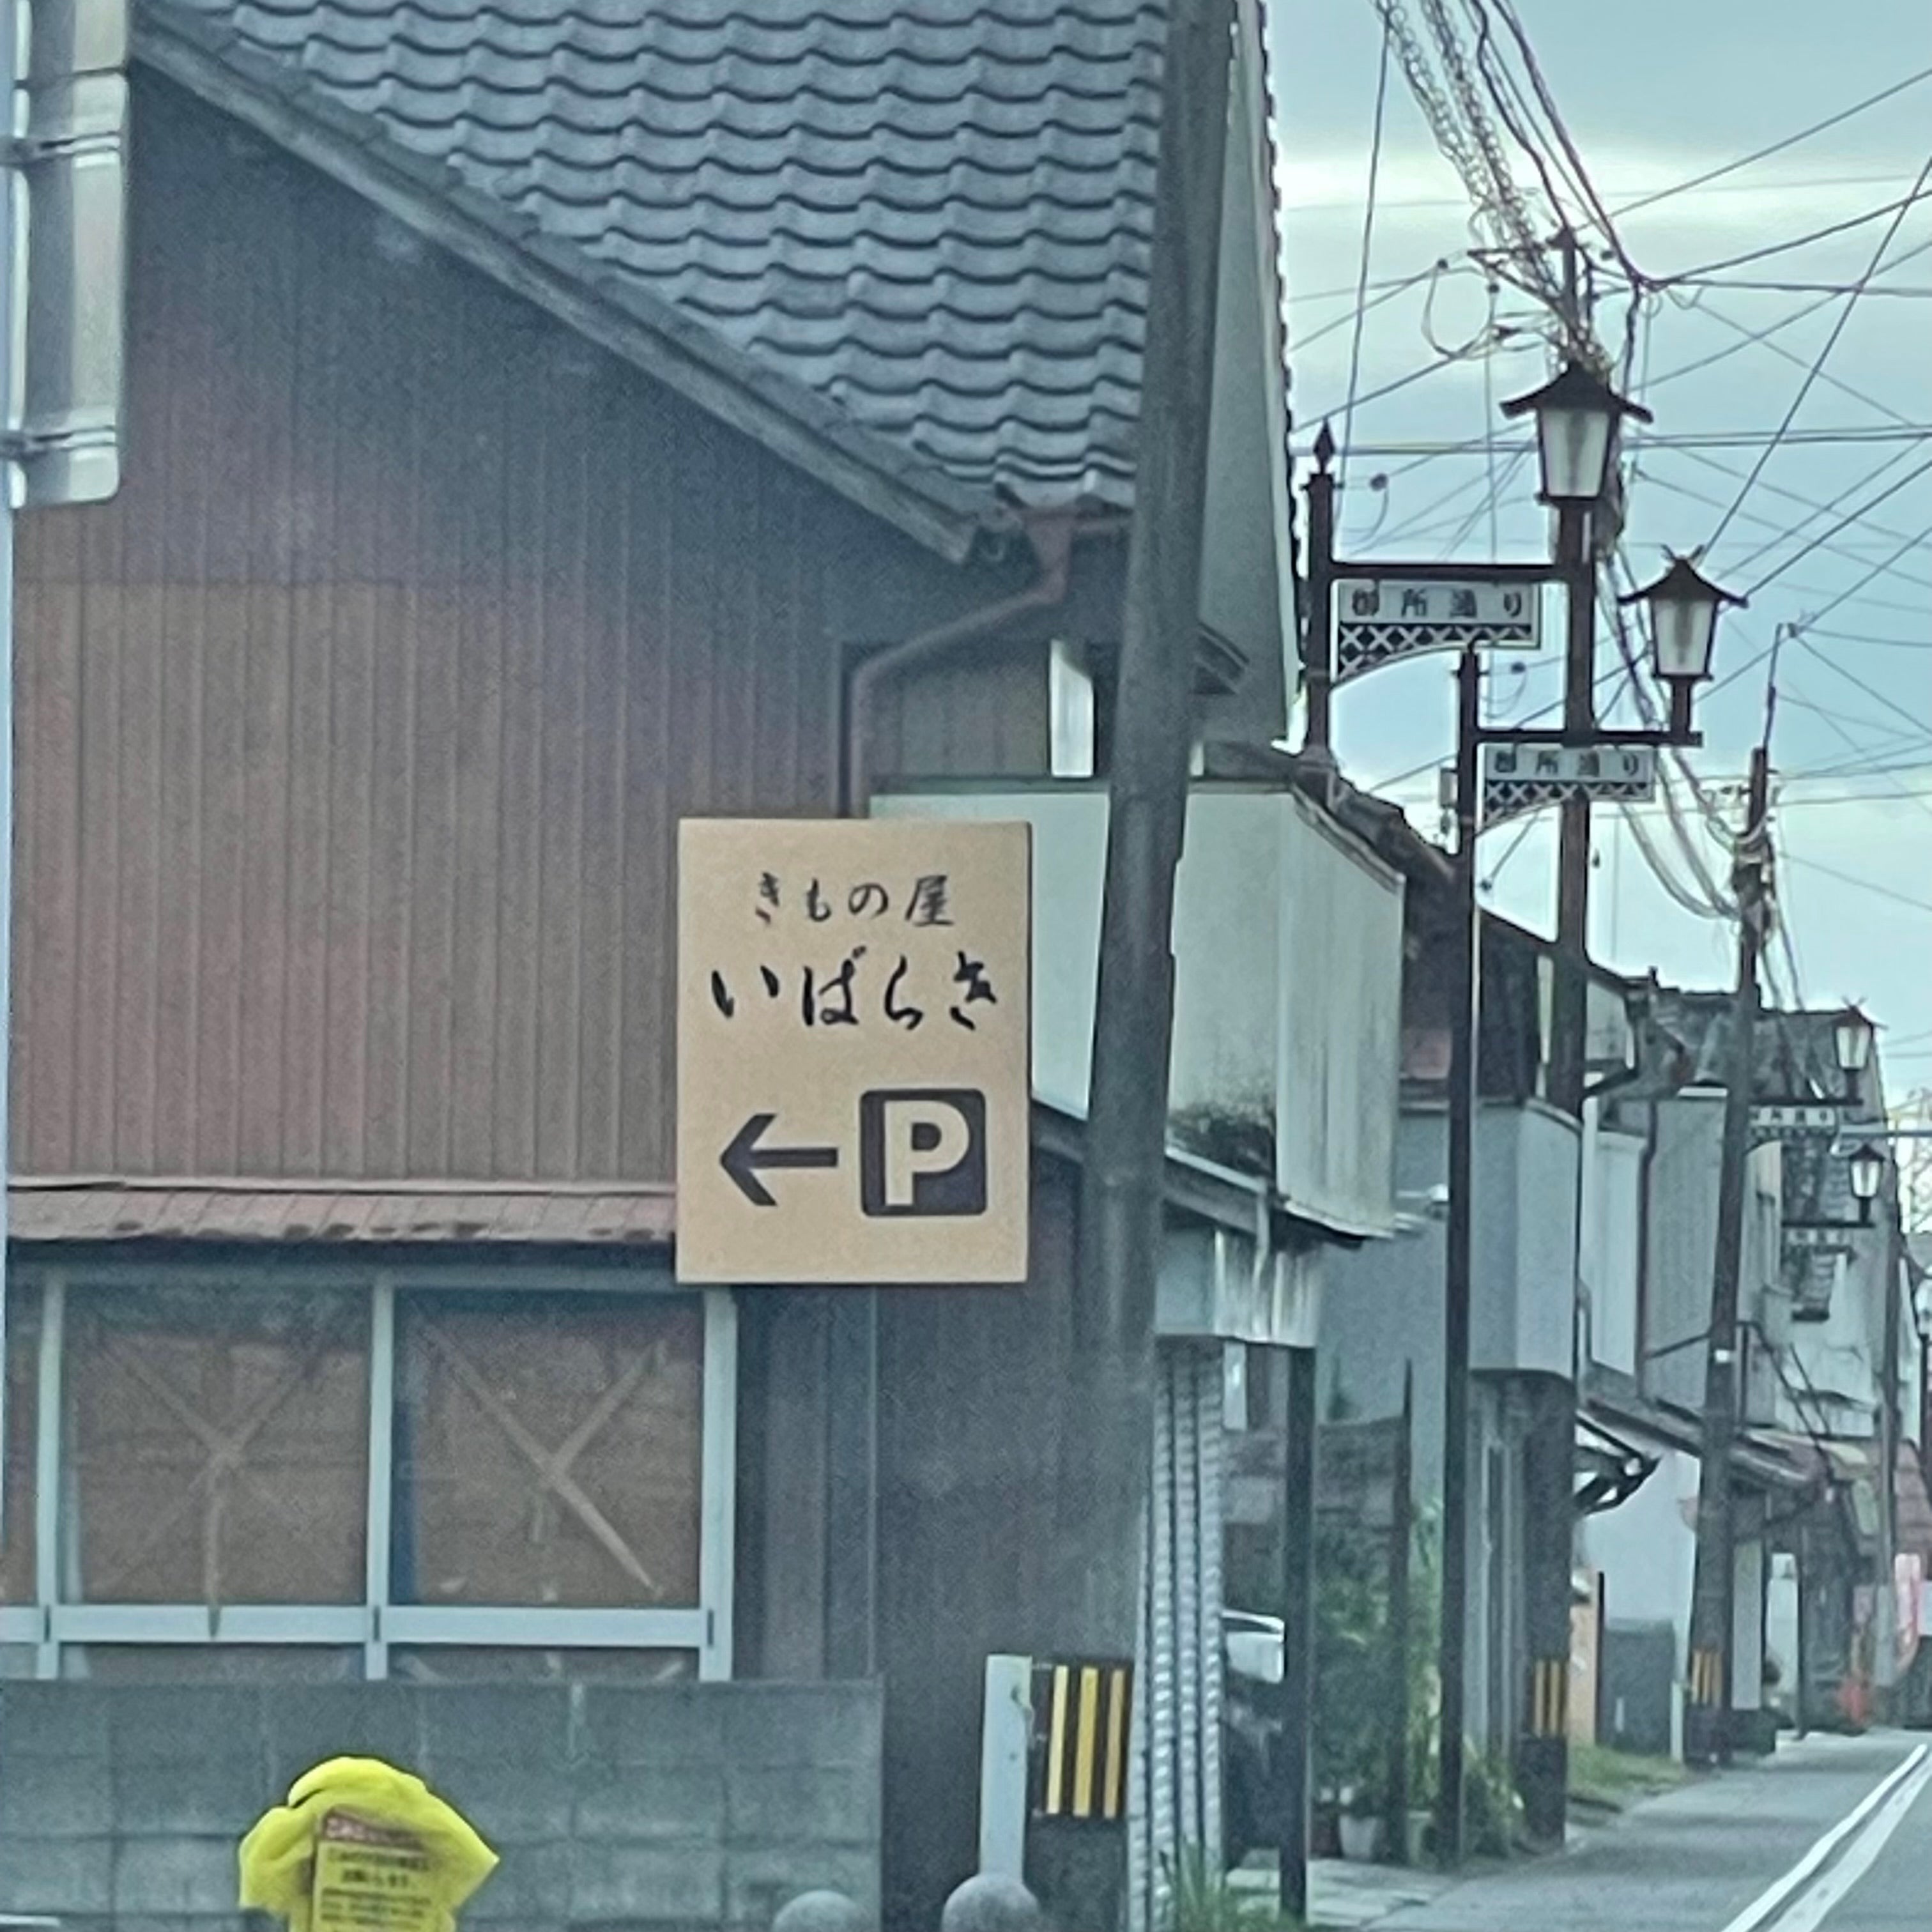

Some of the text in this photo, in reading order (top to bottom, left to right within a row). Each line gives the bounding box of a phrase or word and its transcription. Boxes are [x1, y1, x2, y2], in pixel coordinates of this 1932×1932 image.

[755, 871, 954, 926] きもの屋
[710, 946, 997, 1031] いばらき
[884, 1100, 970, 1206] P
